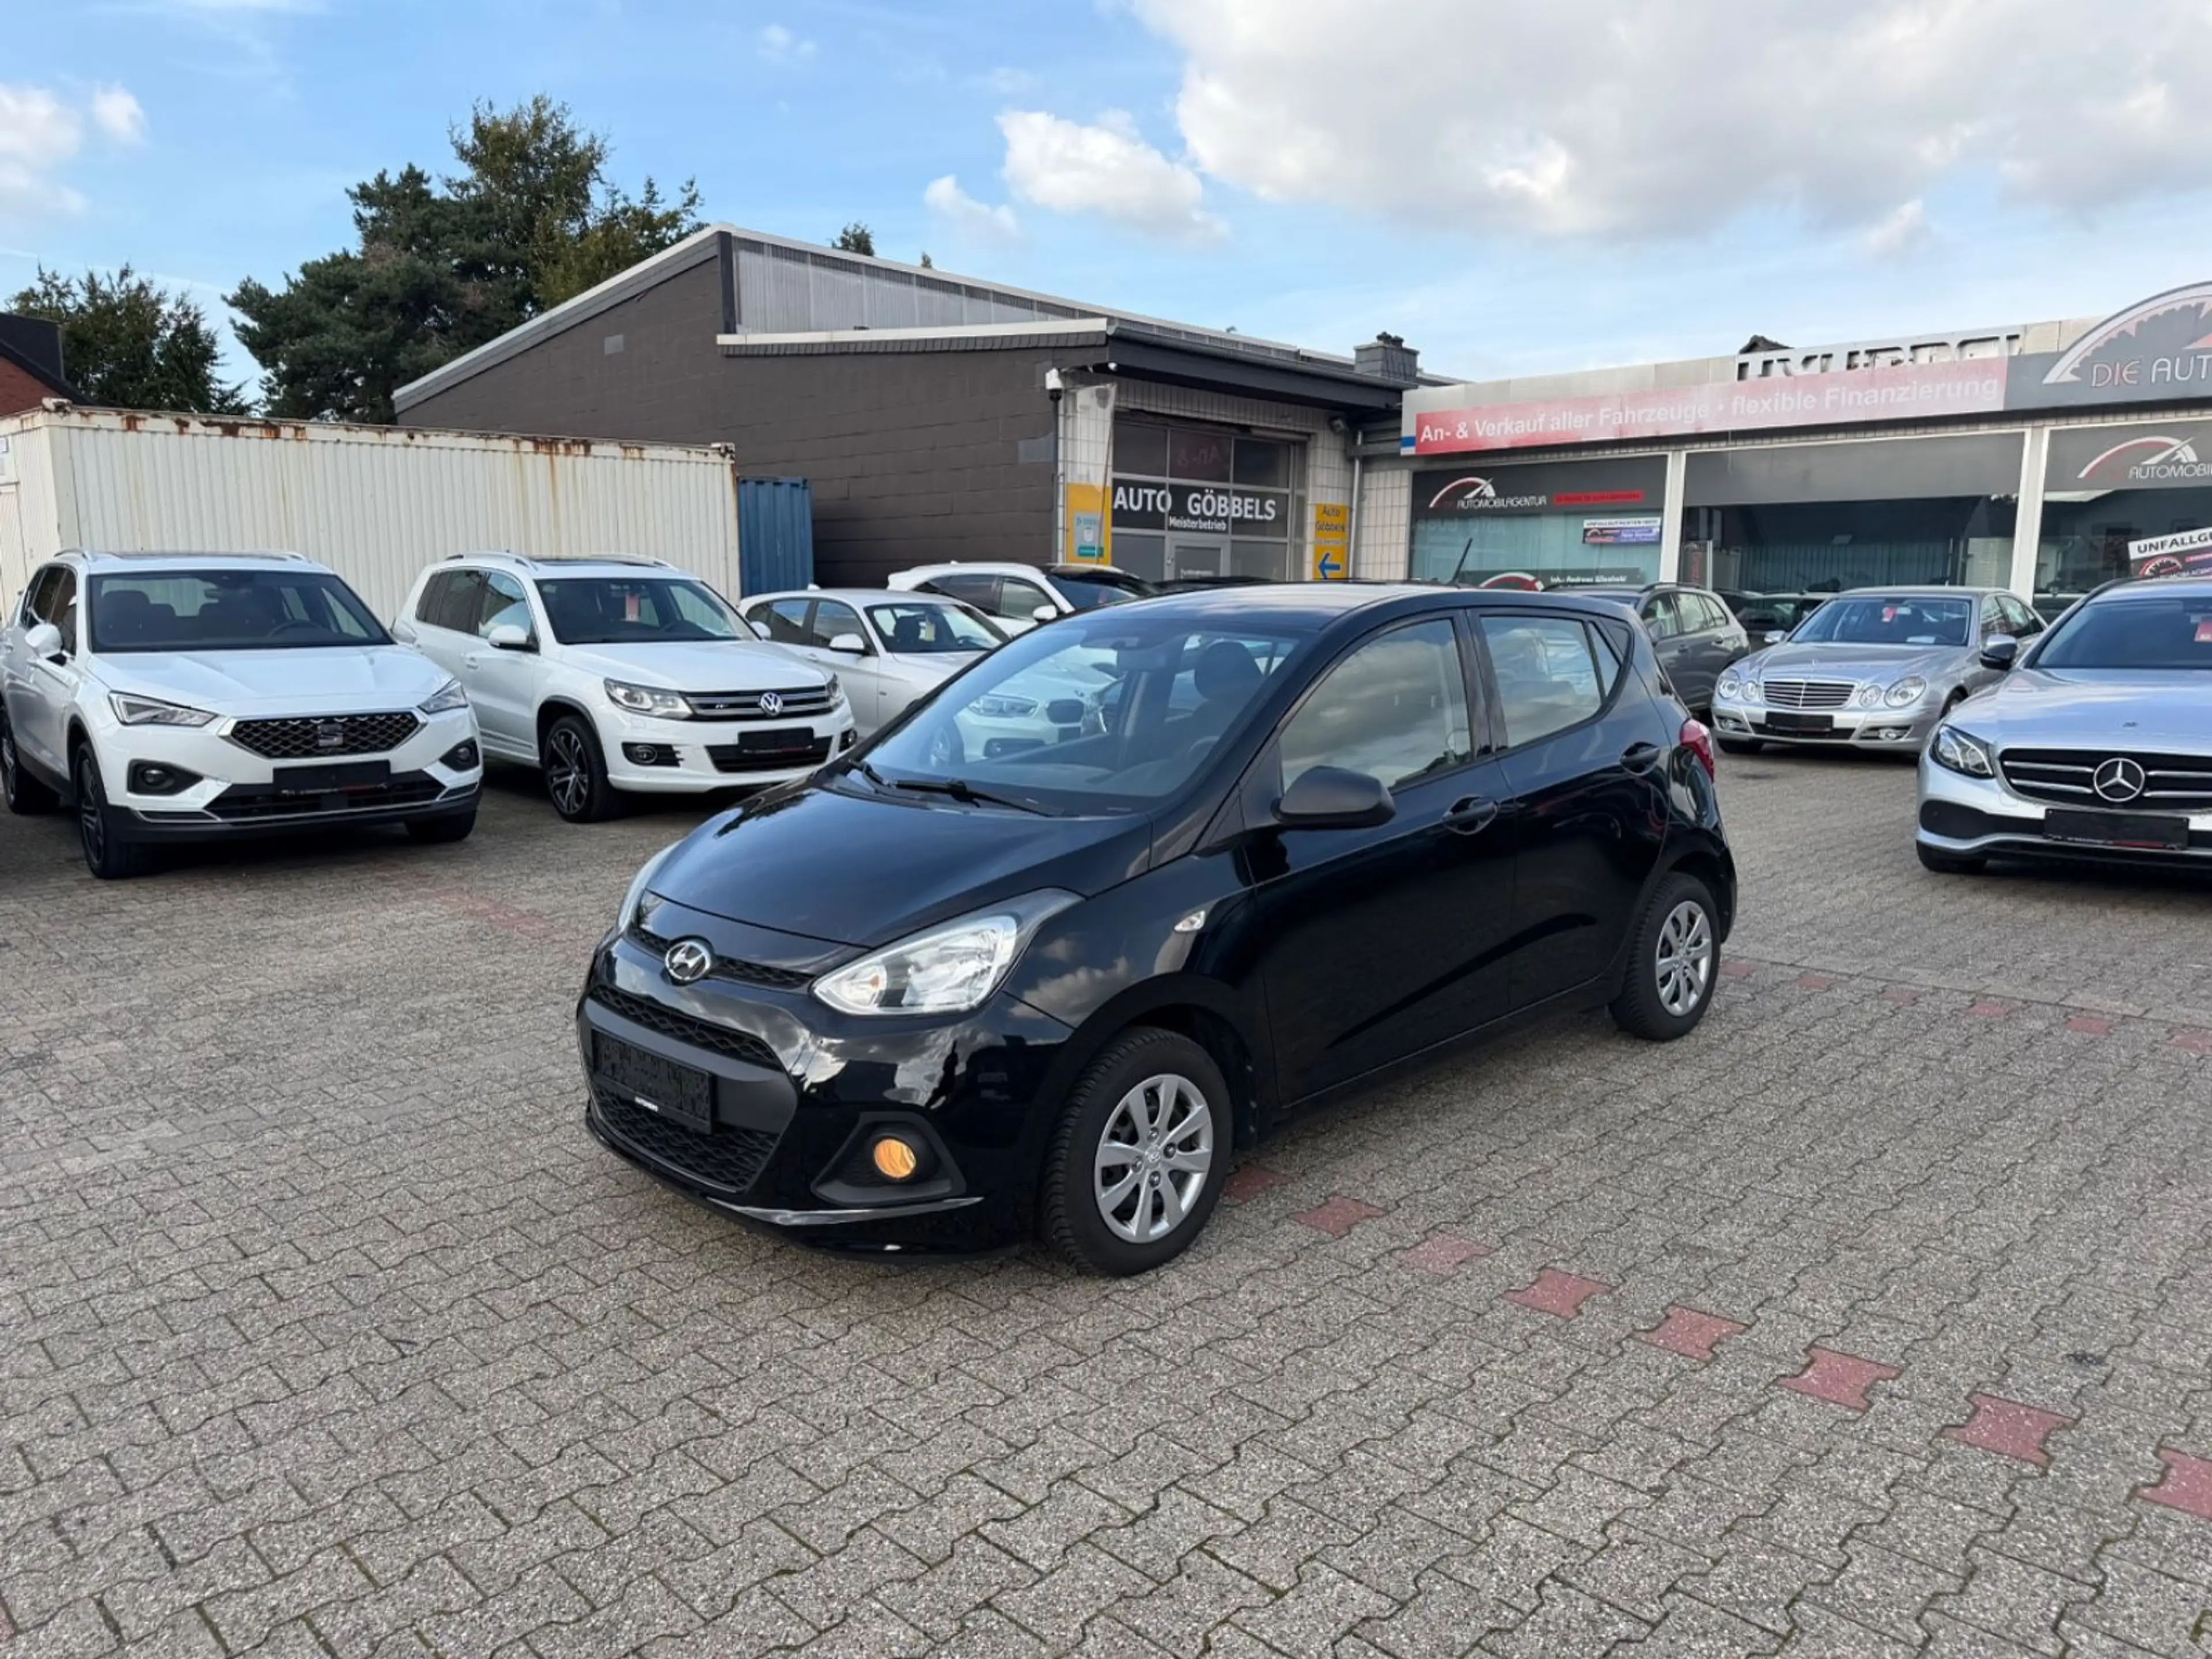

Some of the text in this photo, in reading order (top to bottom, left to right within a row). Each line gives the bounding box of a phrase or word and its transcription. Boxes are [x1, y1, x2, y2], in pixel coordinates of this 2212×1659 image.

[2092, 360, 2141, 387] DIE
[1421, 377, 1999, 442] An- & Verkauf aller Fahrzeuge flexible Finanzierung
[1113, 486, 1277, 521] AUTO GÖBBELS
[1169, 515, 1227, 531] Meisterbetrieb
